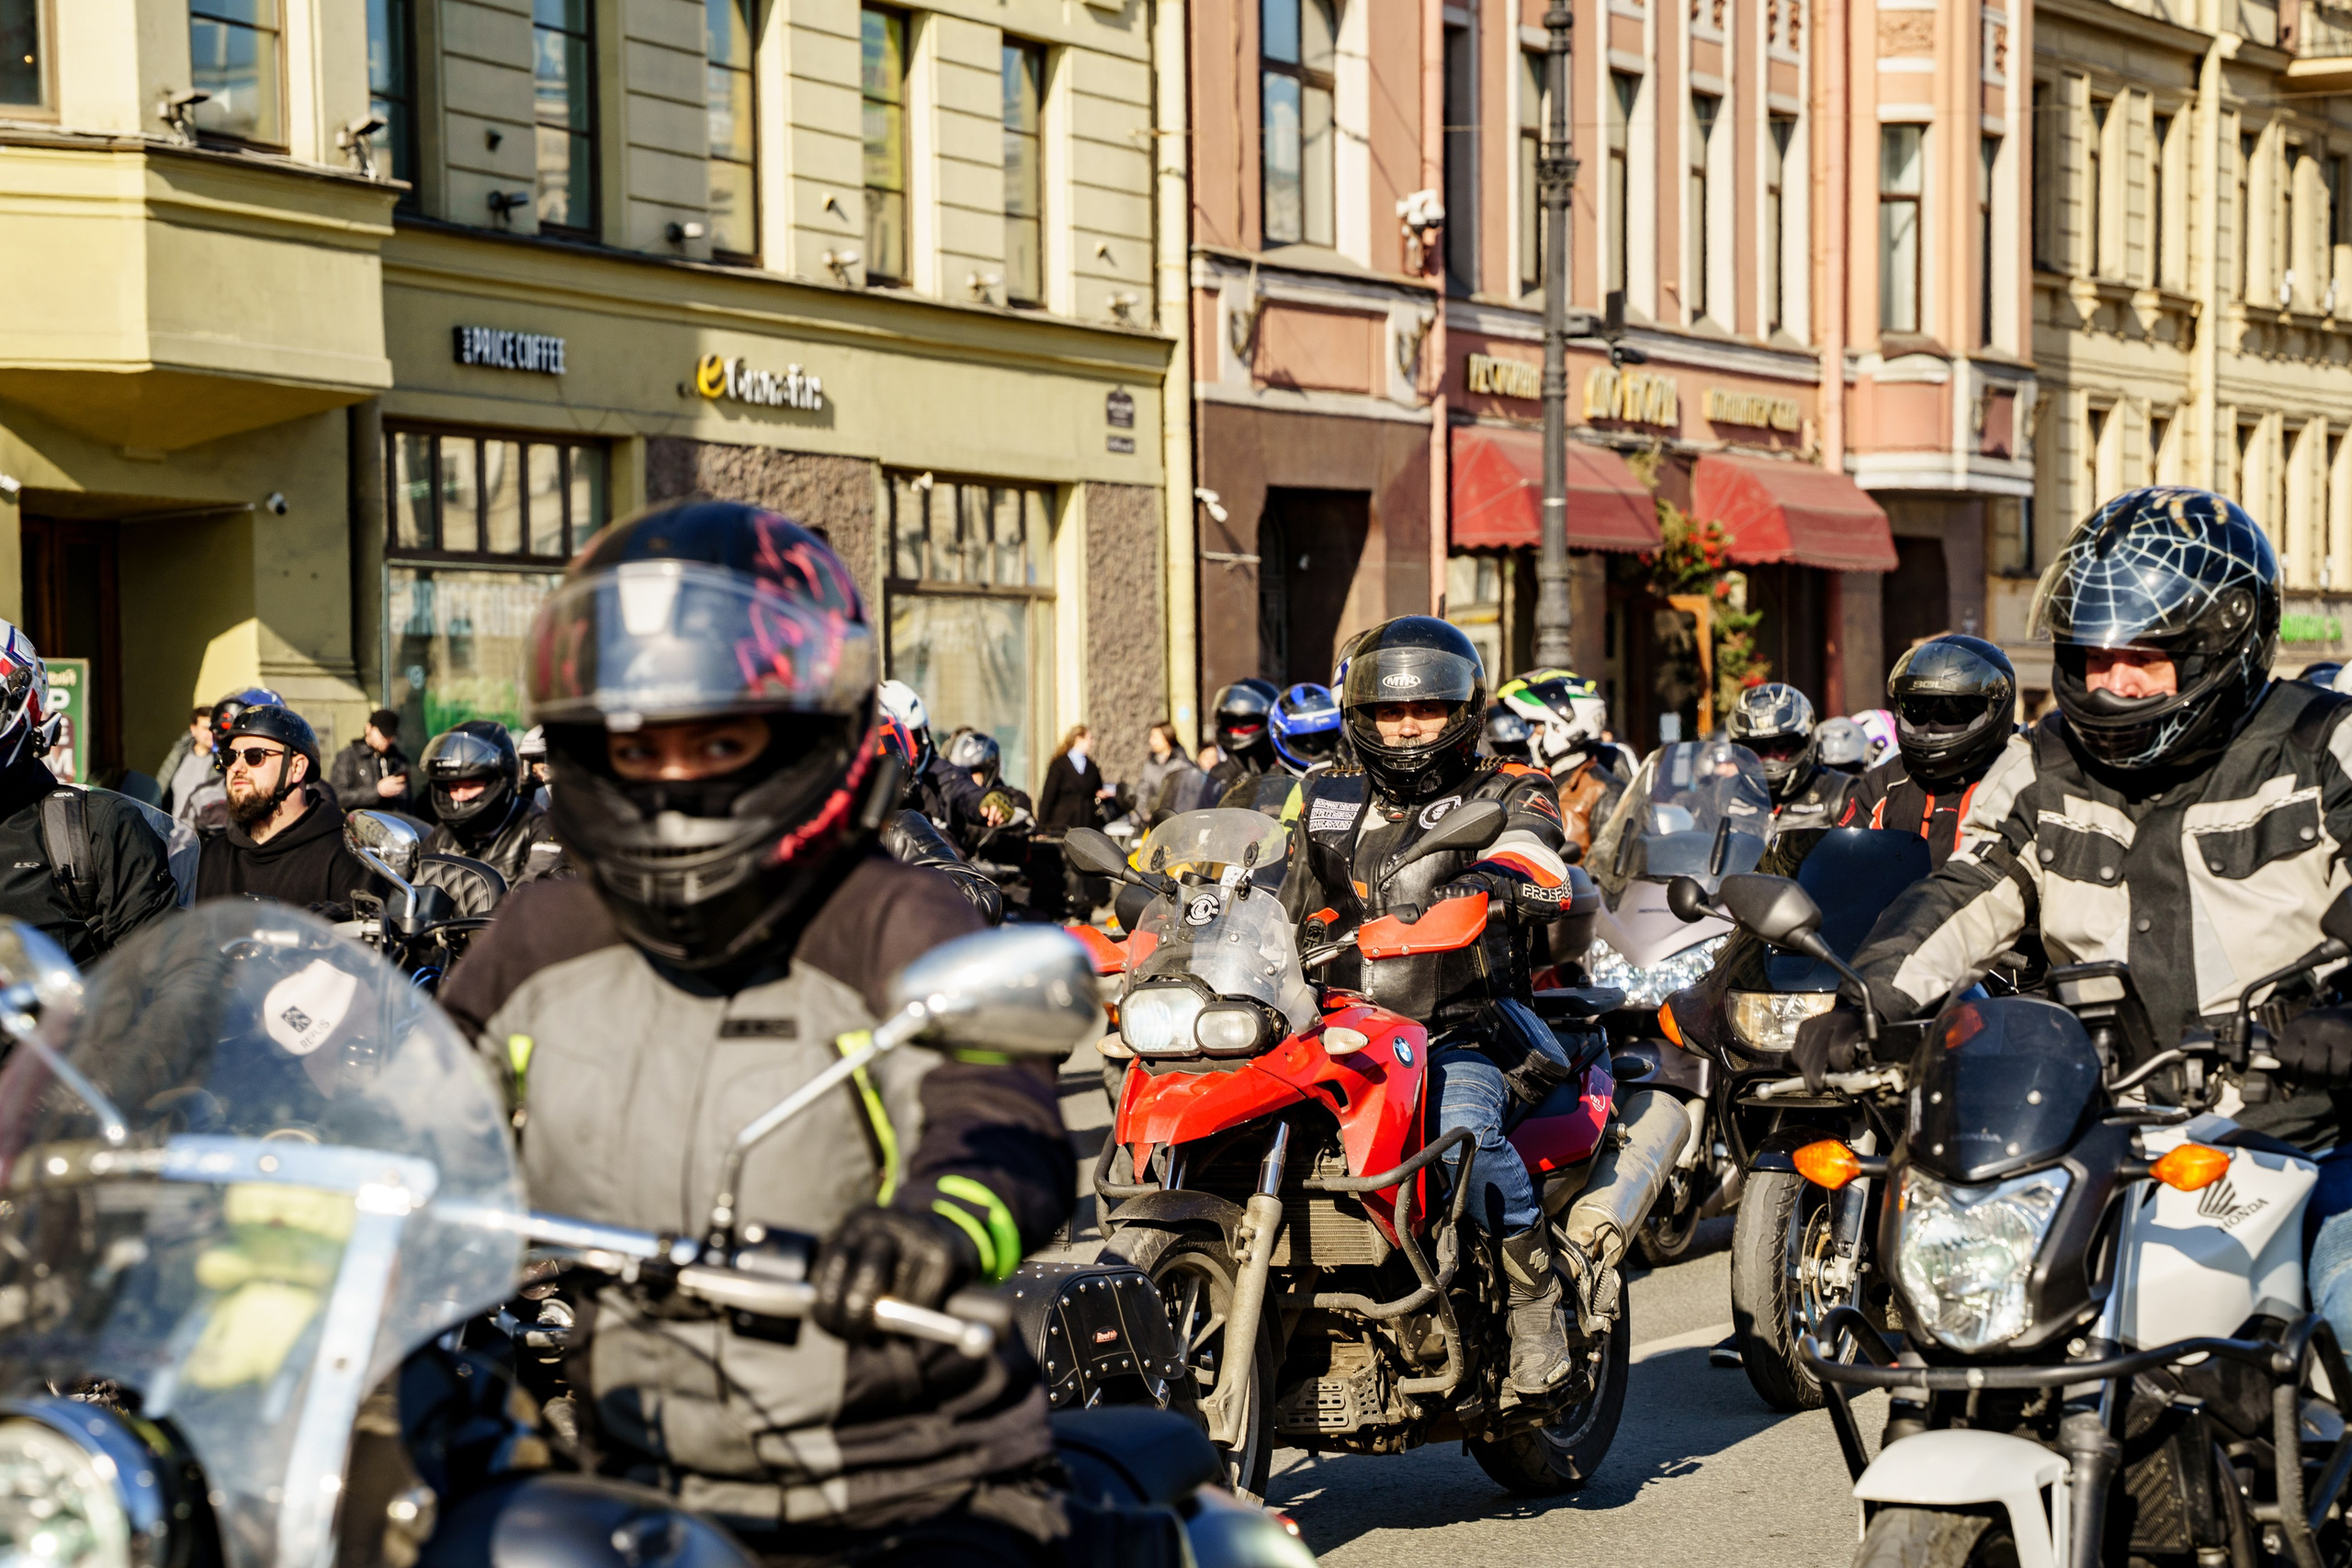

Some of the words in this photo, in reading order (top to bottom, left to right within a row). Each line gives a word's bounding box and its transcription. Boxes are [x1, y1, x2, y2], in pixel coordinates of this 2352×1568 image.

[472, 326, 515, 368] PRICE
[516, 332, 567, 375] COFFEE
[1913, 680, 1944, 689] SOL
[2217, 1198, 2270, 1234] HONDA
